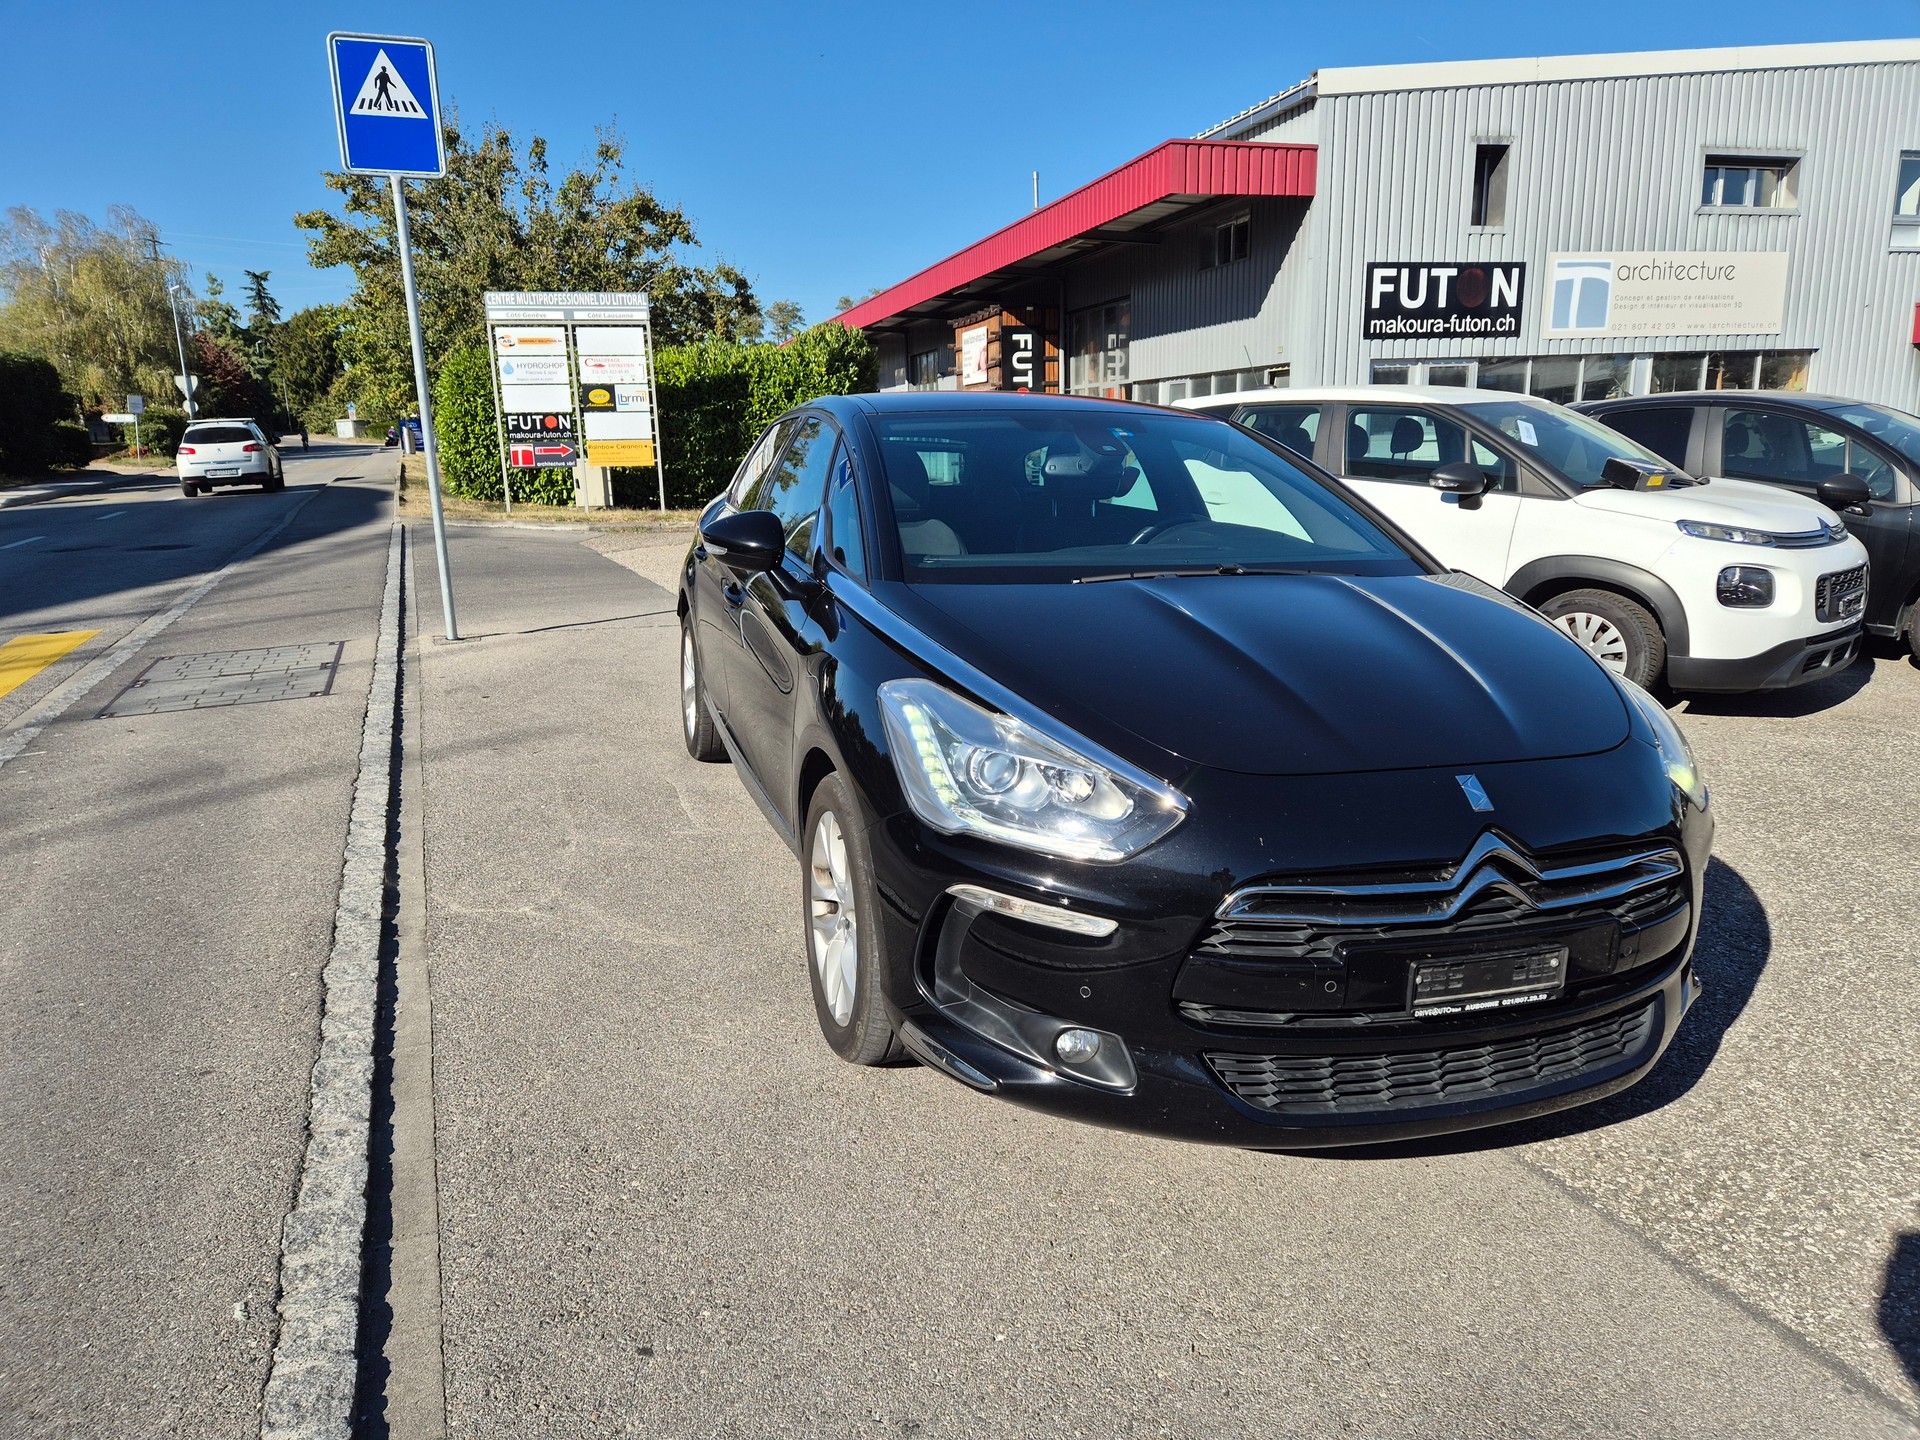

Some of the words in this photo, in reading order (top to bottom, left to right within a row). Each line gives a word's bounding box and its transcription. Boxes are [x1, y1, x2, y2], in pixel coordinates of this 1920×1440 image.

[1616, 258, 1736, 281] architecture
[1371, 267, 1520, 309] FUTON
[487, 293, 515, 305] CENTRE
[517, 293, 598, 305] MULTIPROFESSIONNEL
[600, 293, 611, 305] DU
[612, 293, 647, 305] LITTORAL
[1614, 293, 1644, 303] Concept
[1655, 293, 1681, 303] gestion
[1694, 292, 1734, 300] réalisations
[1613, 302, 1638, 311] Design
[1688, 301, 1732, 309] visualisation
[587, 311, 601, 319] Côté
[1370, 314, 1516, 334] makoura-futon.ch
[1611, 323, 1628, 331] 021
[1631, 323, 1648, 331] 807
[1651, 322, 1662, 330] 42
[1665, 322, 1676, 330] 09
[1686, 321, 1778, 330] www.tarchitecture.ch
[507, 414, 571, 430] FUTON
[509, 430, 572, 439] makoura-futon.ch
[1464, 1001, 1500, 1011] AUBONNE
